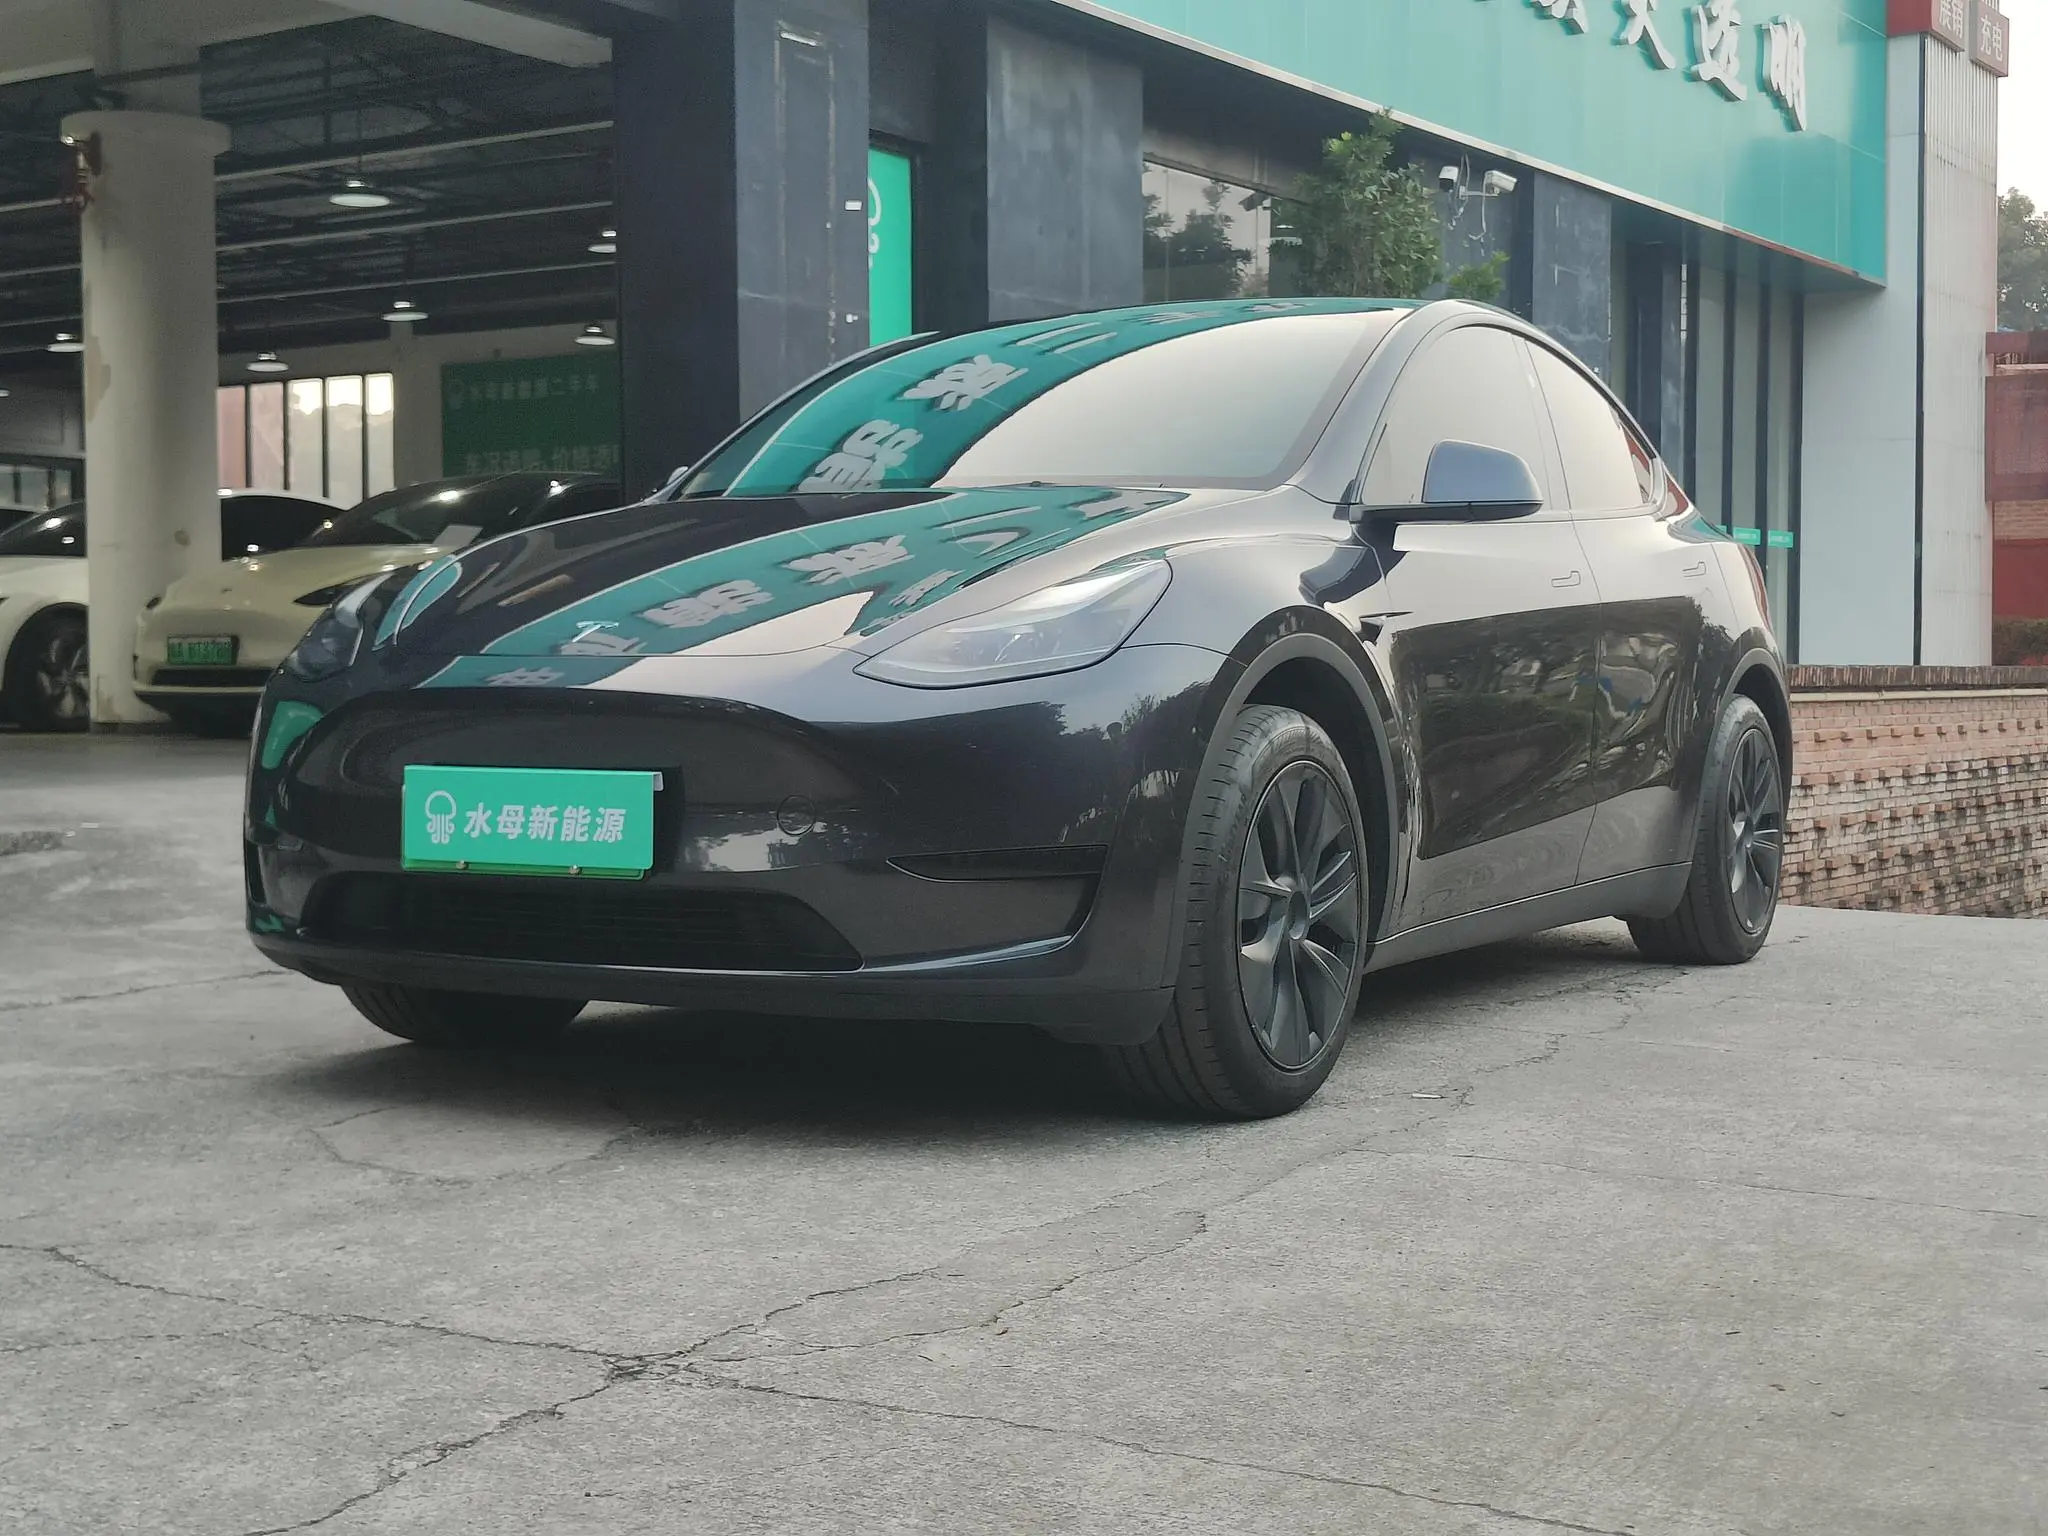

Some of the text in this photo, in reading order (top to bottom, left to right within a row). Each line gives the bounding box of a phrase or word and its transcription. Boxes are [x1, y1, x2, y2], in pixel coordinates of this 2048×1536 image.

[1980, 14, 2003, 61] 充电
[1528, 0, 1806, 131] 透明
[463, 802, 627, 843] 水母新能源
